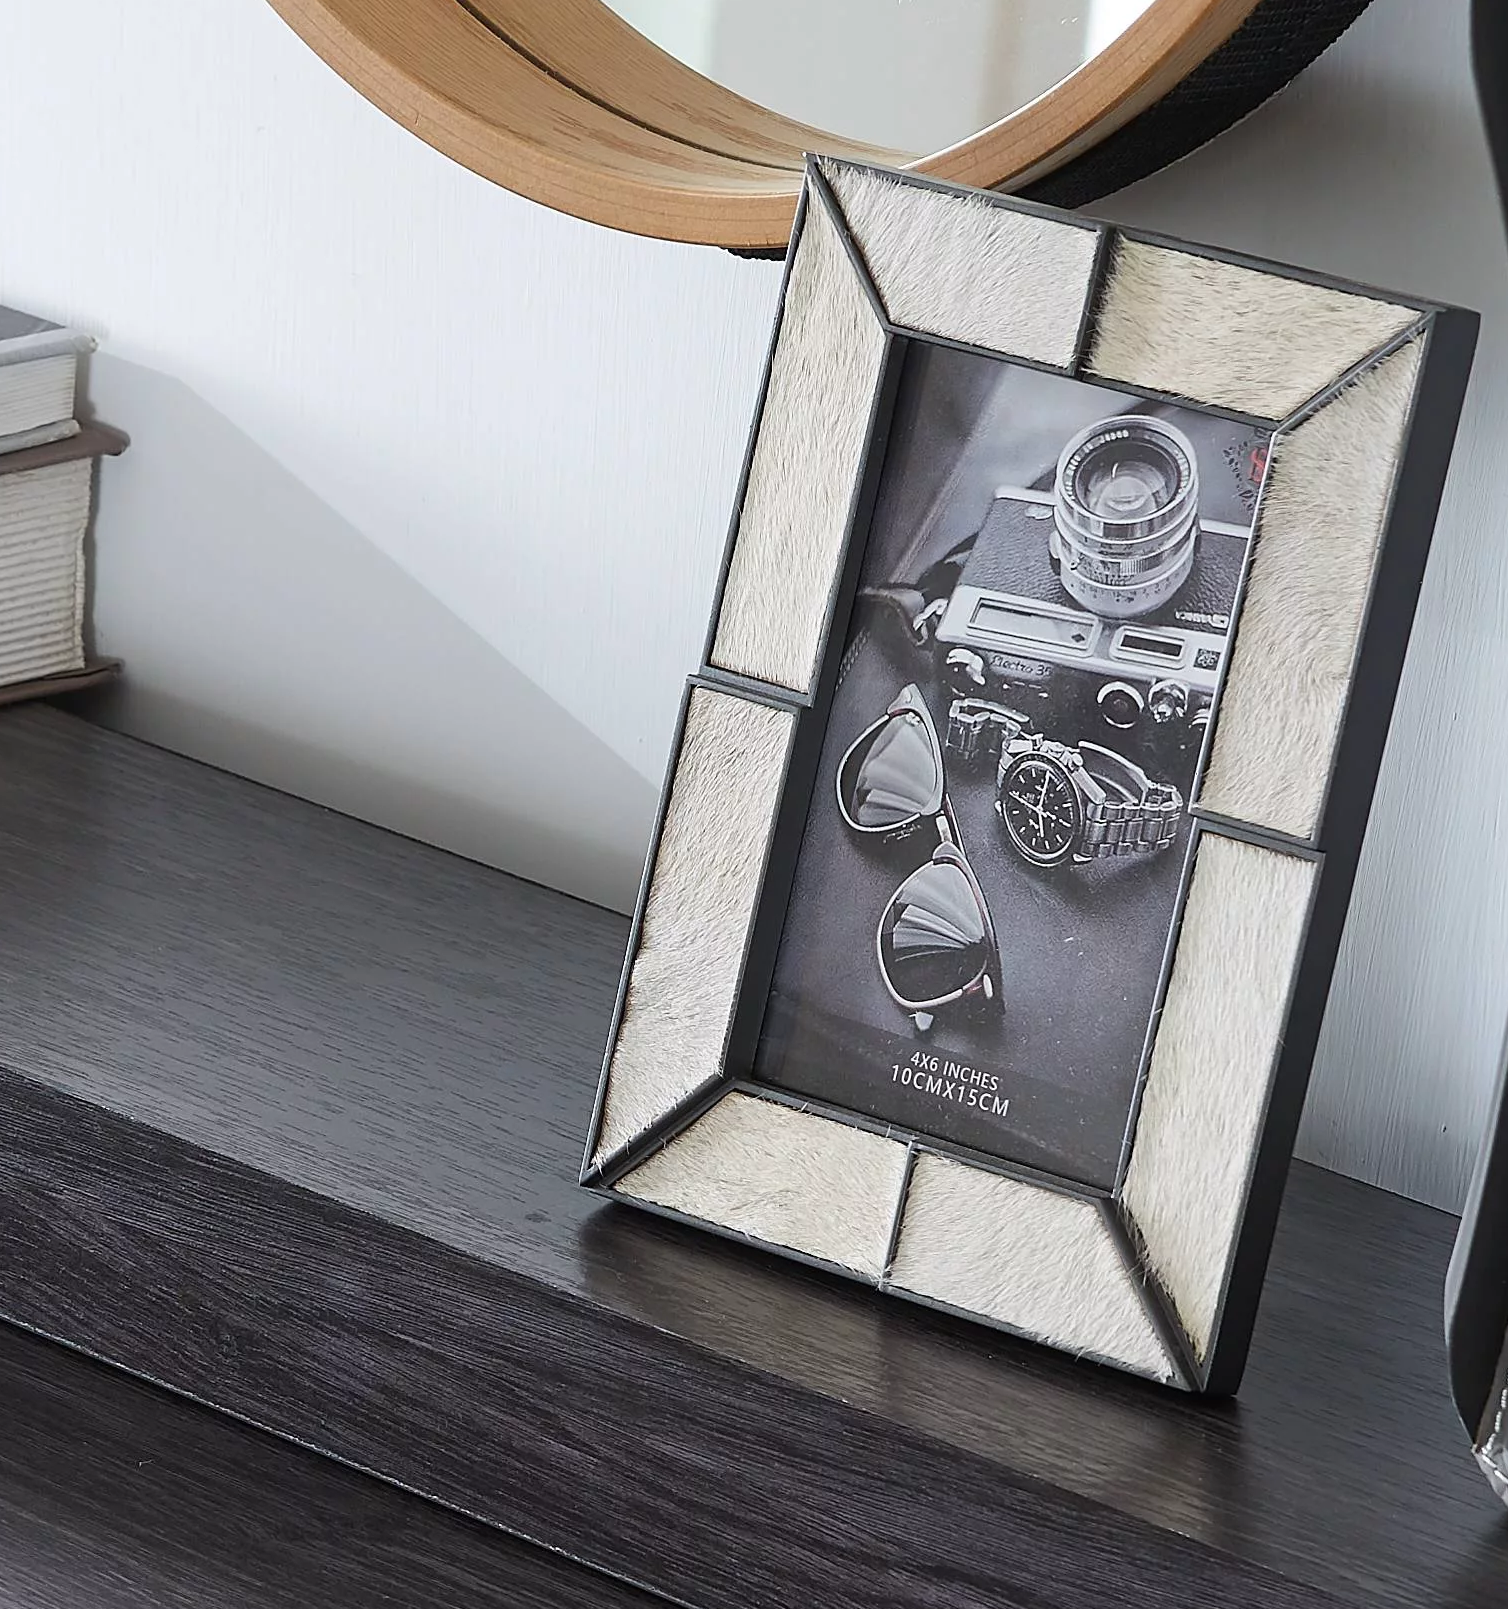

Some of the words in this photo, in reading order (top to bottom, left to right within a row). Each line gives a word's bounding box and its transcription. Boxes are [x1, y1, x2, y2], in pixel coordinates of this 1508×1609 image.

[891, 1064, 1010, 1117] 10CMX15CM
[910, 1051, 939, 1072] 4X6
[943, 1061, 999, 1091] INCHES
